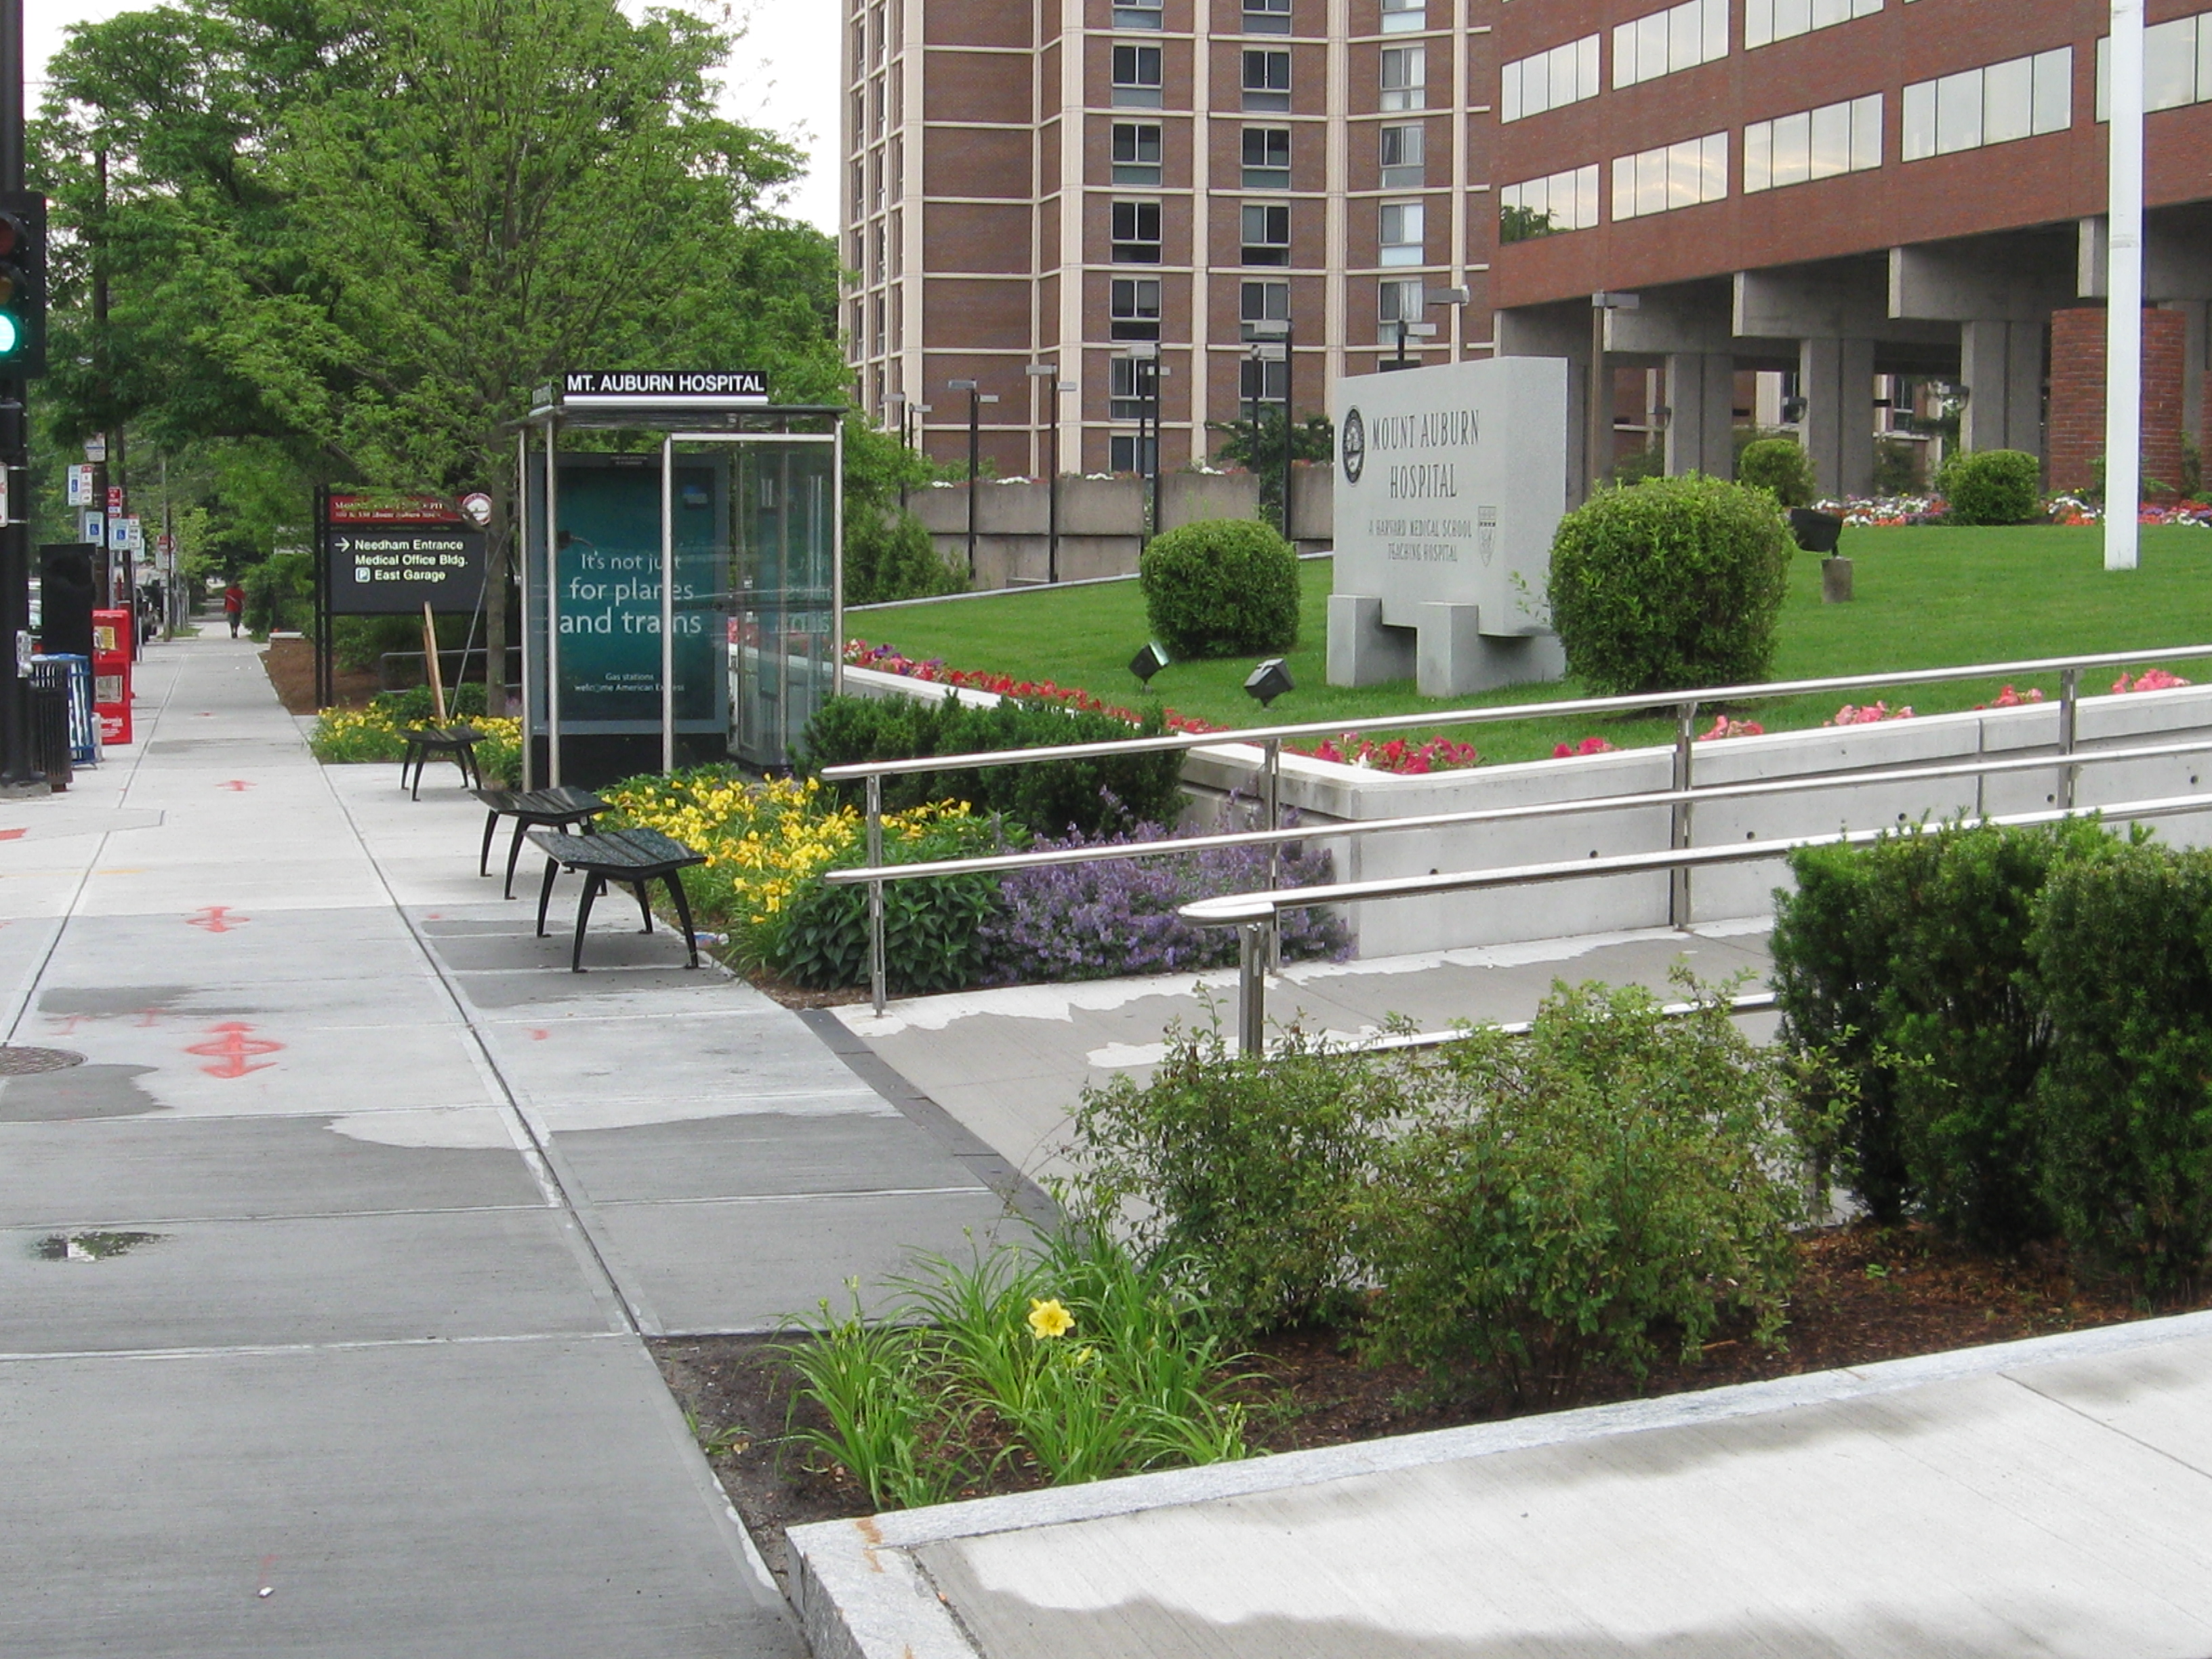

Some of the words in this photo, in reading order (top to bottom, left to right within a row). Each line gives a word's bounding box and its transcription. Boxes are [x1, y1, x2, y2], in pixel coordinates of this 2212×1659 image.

[567, 375, 596, 392] MT.
[600, 375, 674, 392] AUBURN
[679, 375, 765, 392] HOSPITAL
[1372, 415, 1415, 450] MOUNT
[1420, 410, 1479, 447] AUBURN
[1390, 464, 1457, 499] HOSPITAL
[1369, 520, 1374, 535] A
[1376, 520, 1406, 536] HARVARD
[1410, 519, 1439, 537] MEDICAL
[1442, 520, 1472, 537] SCHOOL
[354, 539, 409, 550] Needham
[413, 539, 464, 550] Entrance
[1424, 544, 1458, 562] HOSPITAL
[355, 554, 398, 565] Medical
[403, 554, 436, 565] Office
[440, 554, 468, 567] Bldg.
[581, 550, 605, 569] It's
[611, 556, 643, 569] not
[647, 554, 682, 574] jut
[375, 569, 400, 580] East
[403, 569, 446, 582] Garage
[570, 577, 607, 600] for
[559, 607, 611, 633] and
[621, 611, 701, 633] trans
[574, 684, 613, 692] welcome
[615, 684, 655, 692] American
